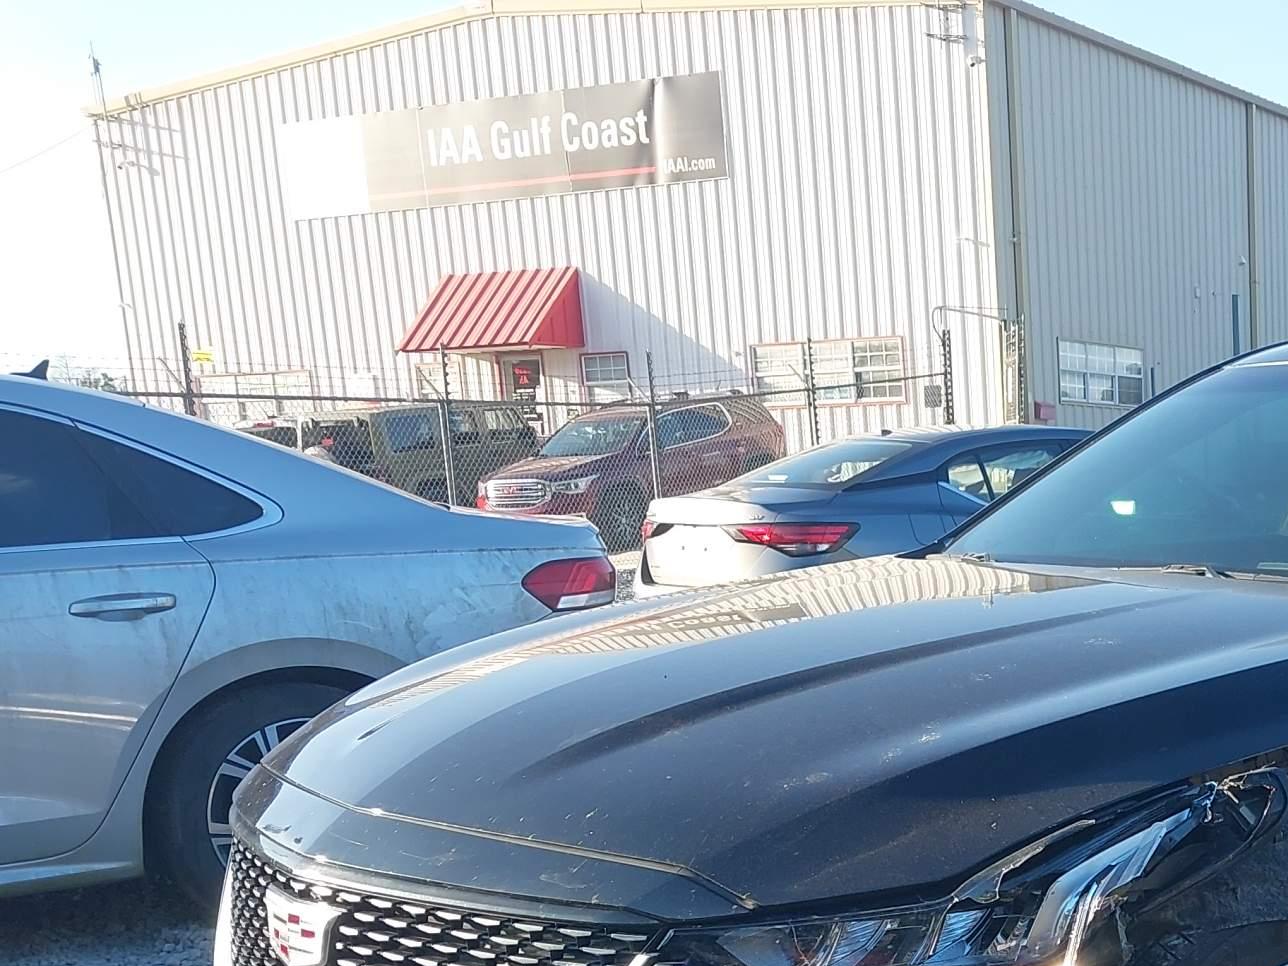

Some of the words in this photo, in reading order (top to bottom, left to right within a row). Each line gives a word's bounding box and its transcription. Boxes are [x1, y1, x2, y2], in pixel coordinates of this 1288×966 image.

[428, 126, 482, 167] IAA
[491, 115, 551, 161] Gulf
[561, 110, 650, 152] Coast
[663, 156, 716, 174] IAAI.com
